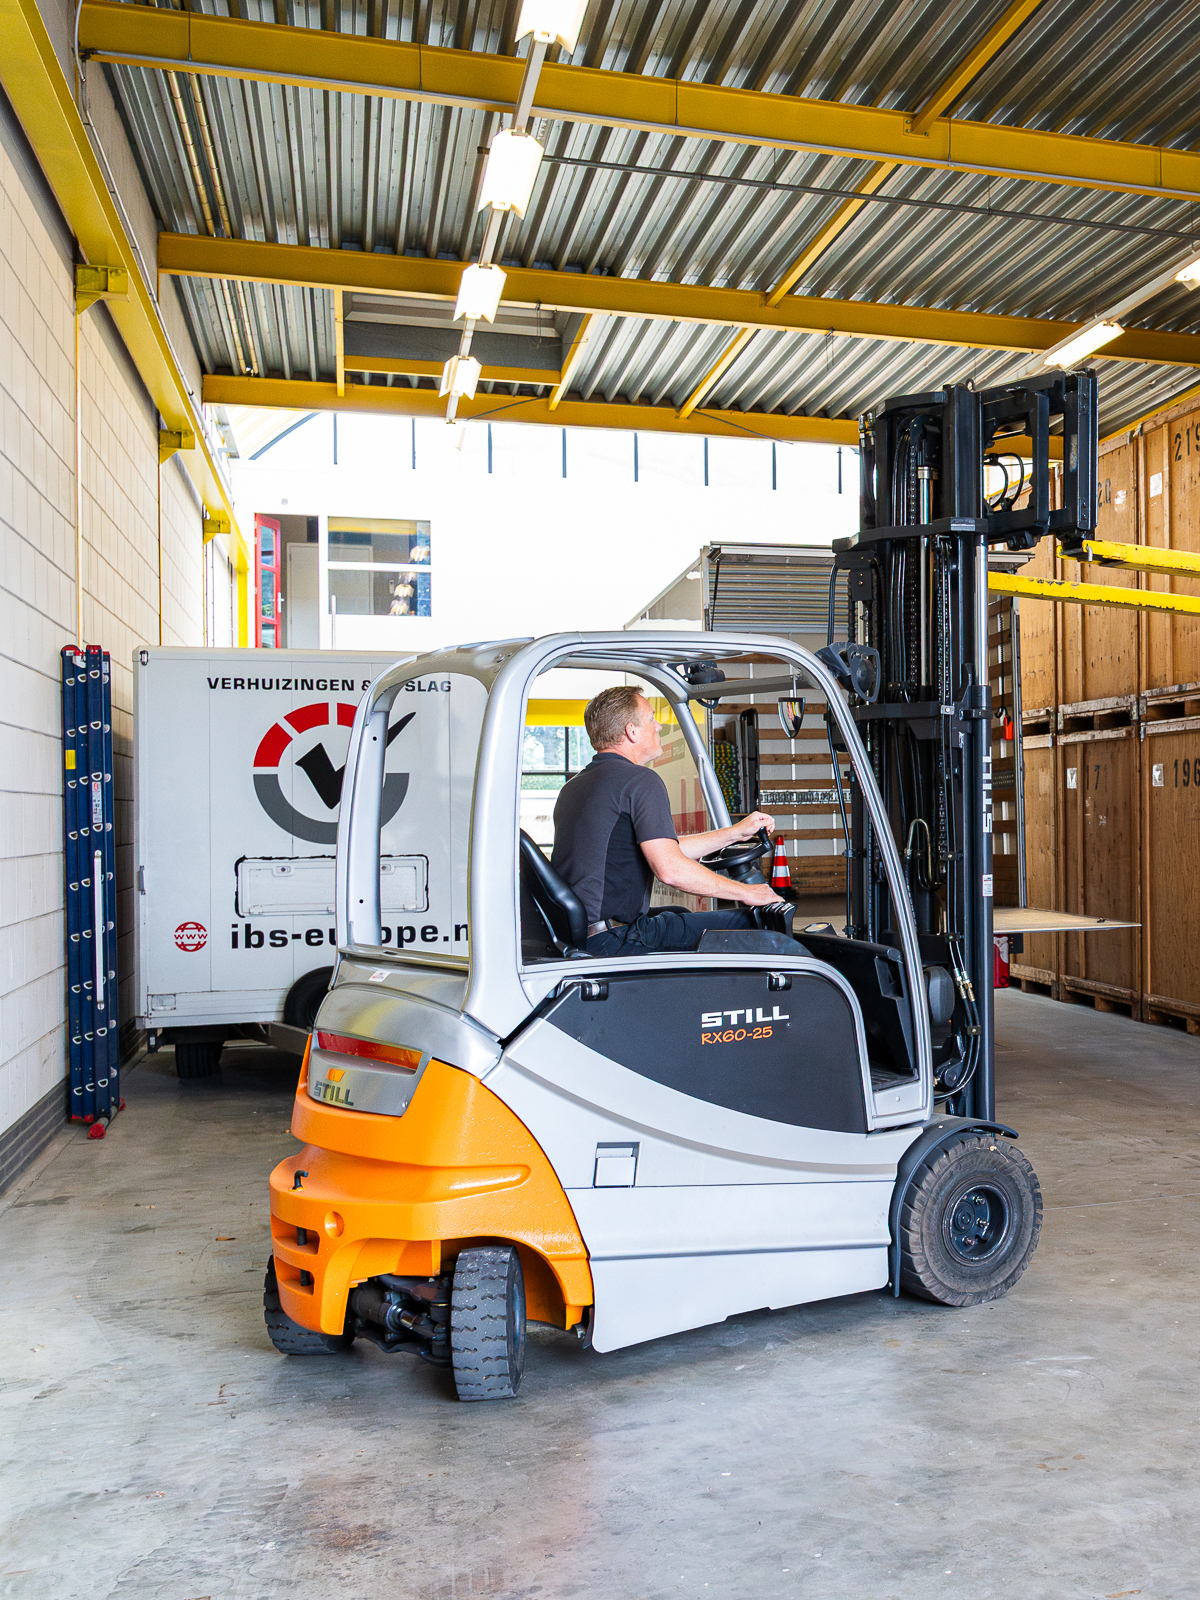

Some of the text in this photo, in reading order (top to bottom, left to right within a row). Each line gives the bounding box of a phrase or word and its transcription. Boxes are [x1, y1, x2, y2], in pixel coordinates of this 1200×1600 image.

[207, 677, 355, 692] VERHUIZINGEN
[982, 746, 993, 833] STILL
[701, 1005, 790, 1029] STILL
[701, 1025, 773, 1045] RX60-25
[314, 1081, 354, 1106] STILL
